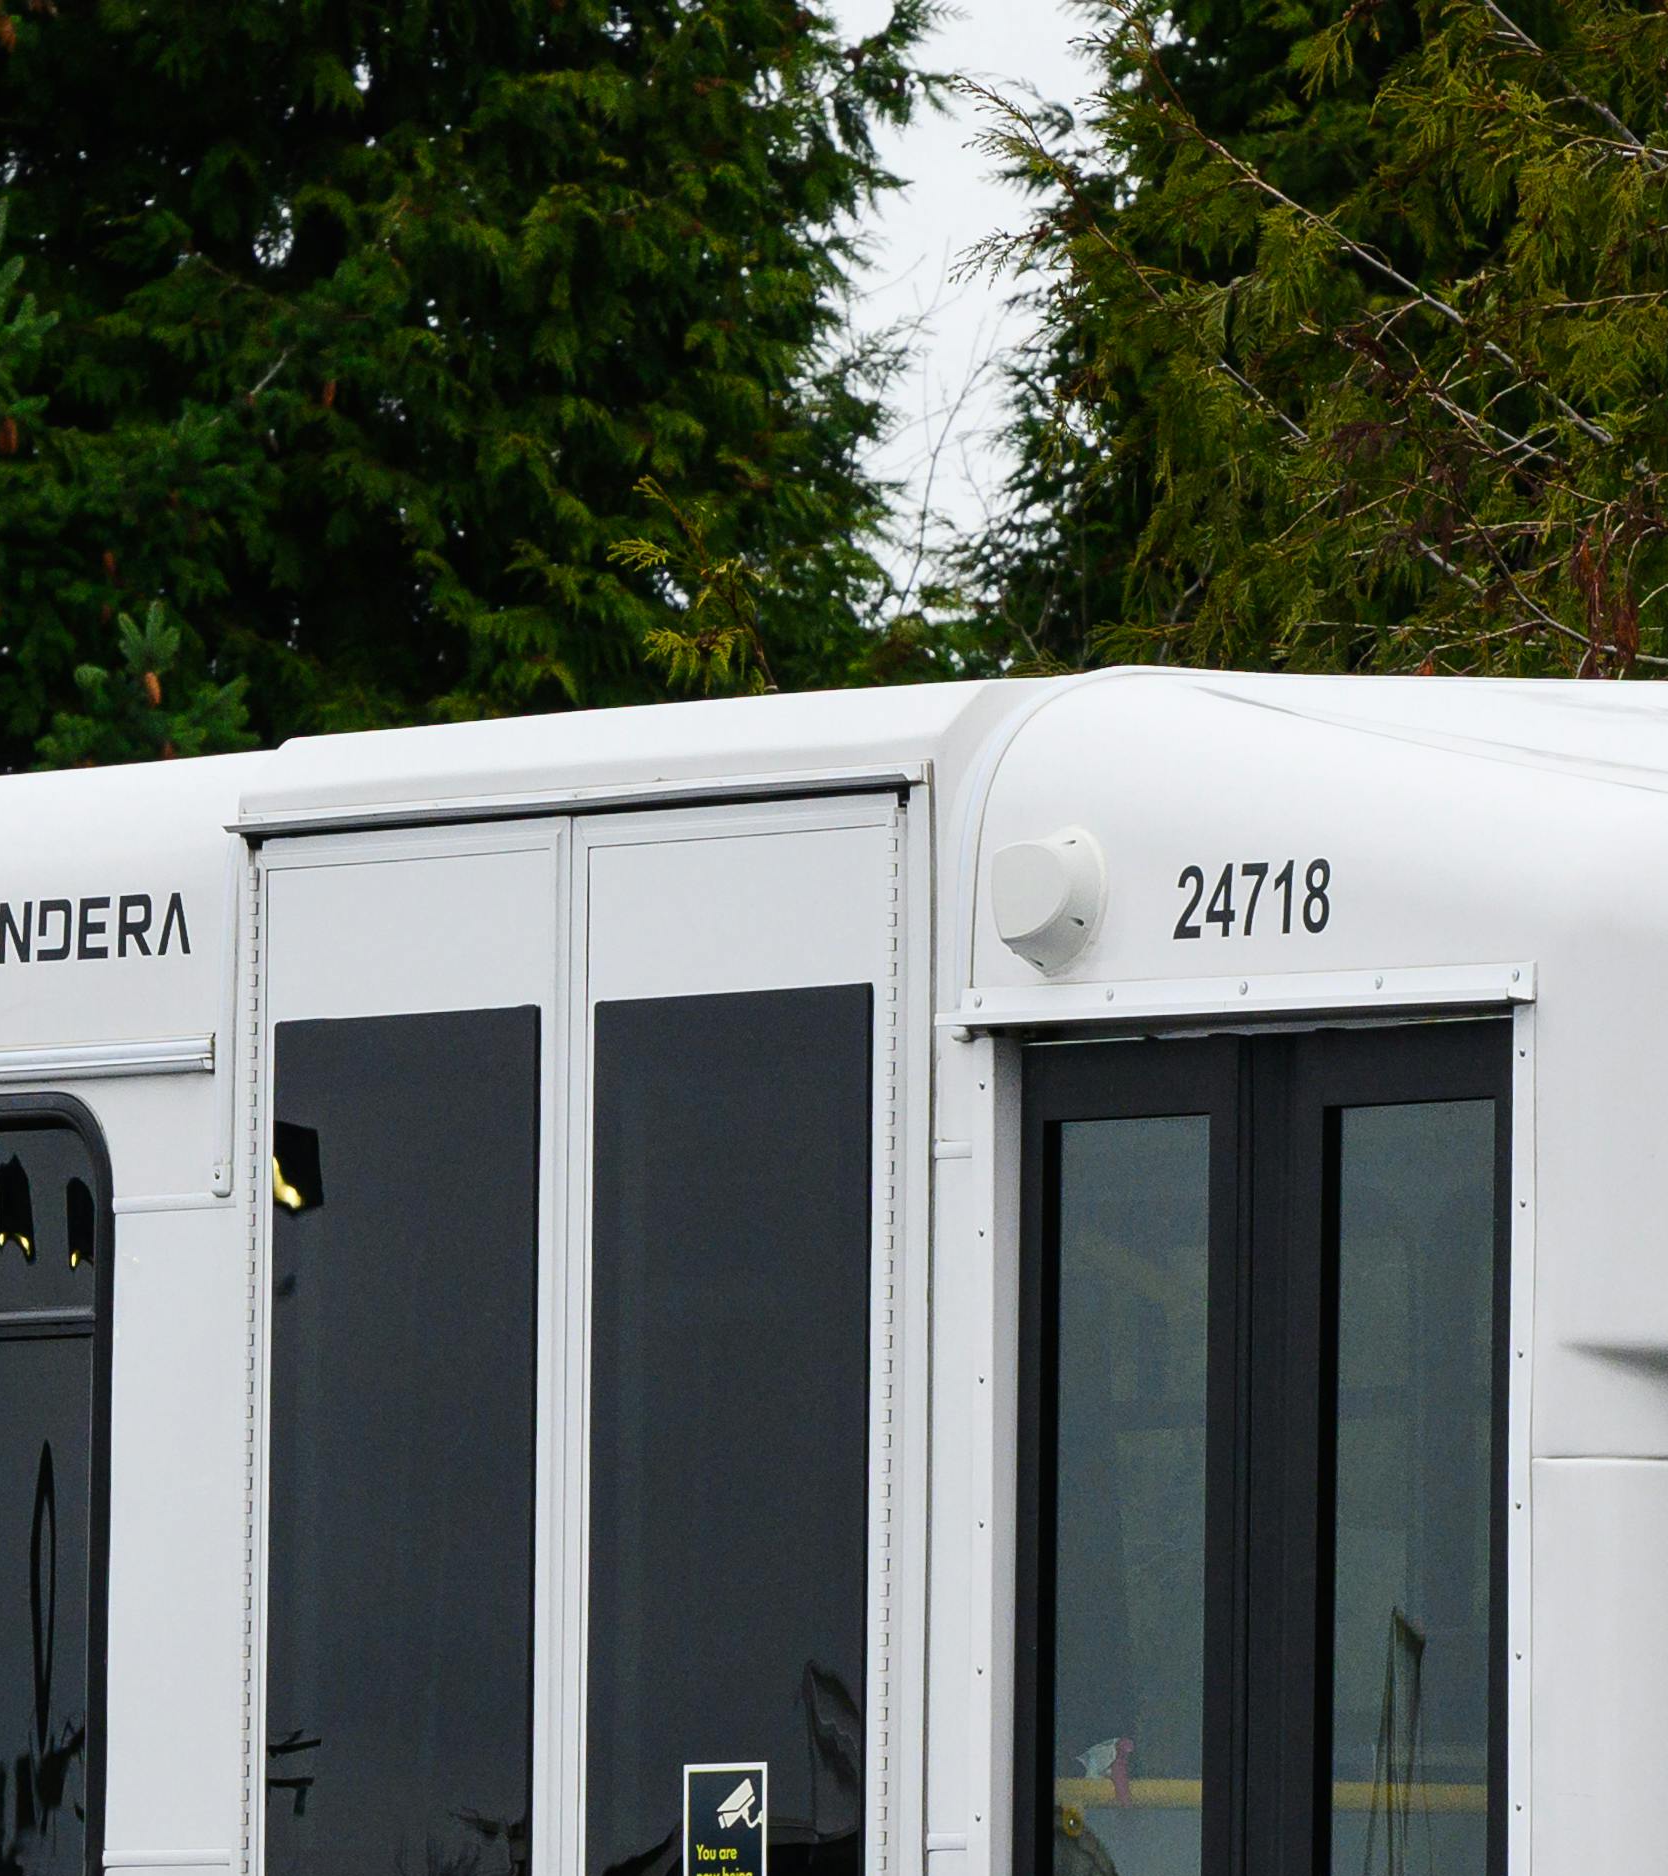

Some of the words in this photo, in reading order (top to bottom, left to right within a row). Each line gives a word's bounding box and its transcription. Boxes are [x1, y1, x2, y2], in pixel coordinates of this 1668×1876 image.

[1173, 858, 1331, 940] 24718
[696, 1844, 716, 1861] You
[718, 1847, 738, 1860] are
